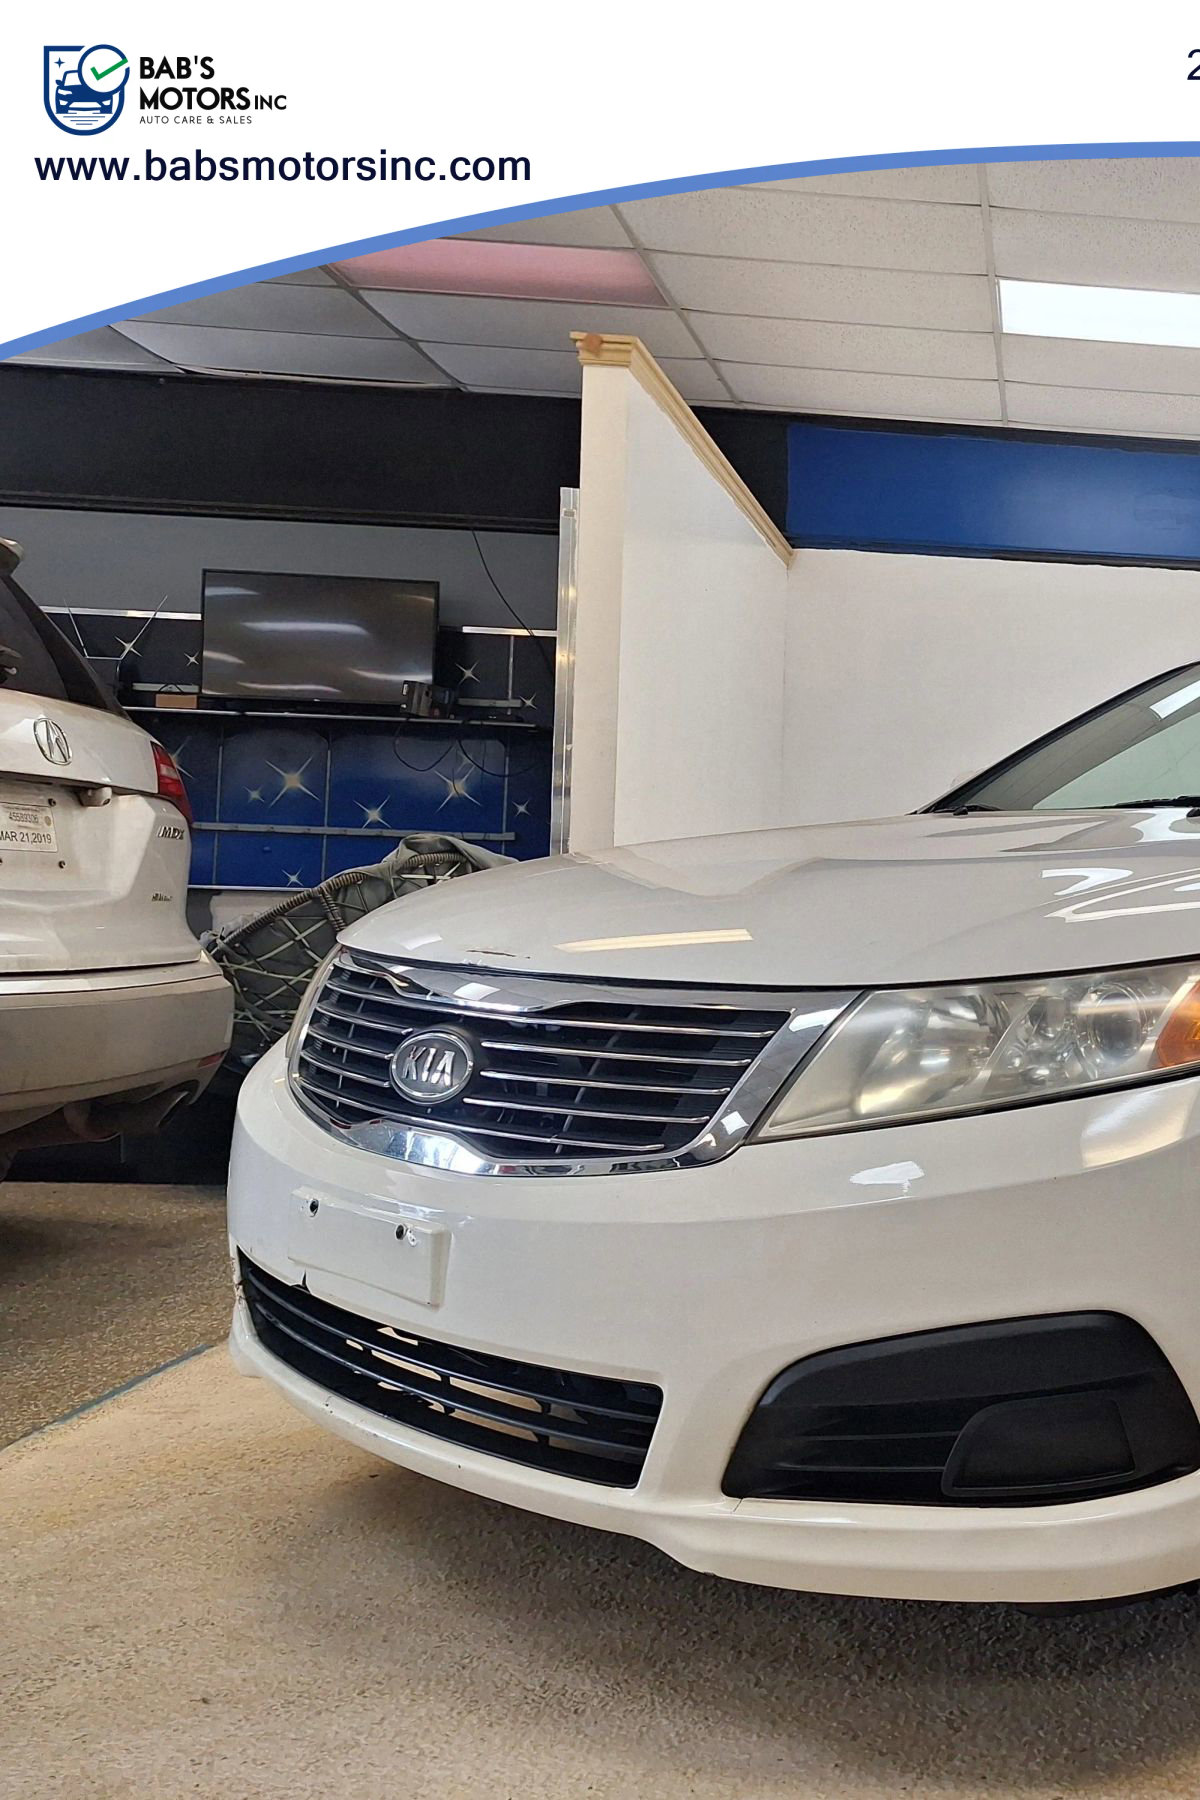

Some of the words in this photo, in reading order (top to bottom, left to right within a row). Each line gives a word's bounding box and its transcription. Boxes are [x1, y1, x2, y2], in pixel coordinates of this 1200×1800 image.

[20, 831, 52, 844] 21,2019
[156, 826, 185, 840] MDX
[402, 1045, 456, 1088] KIA
